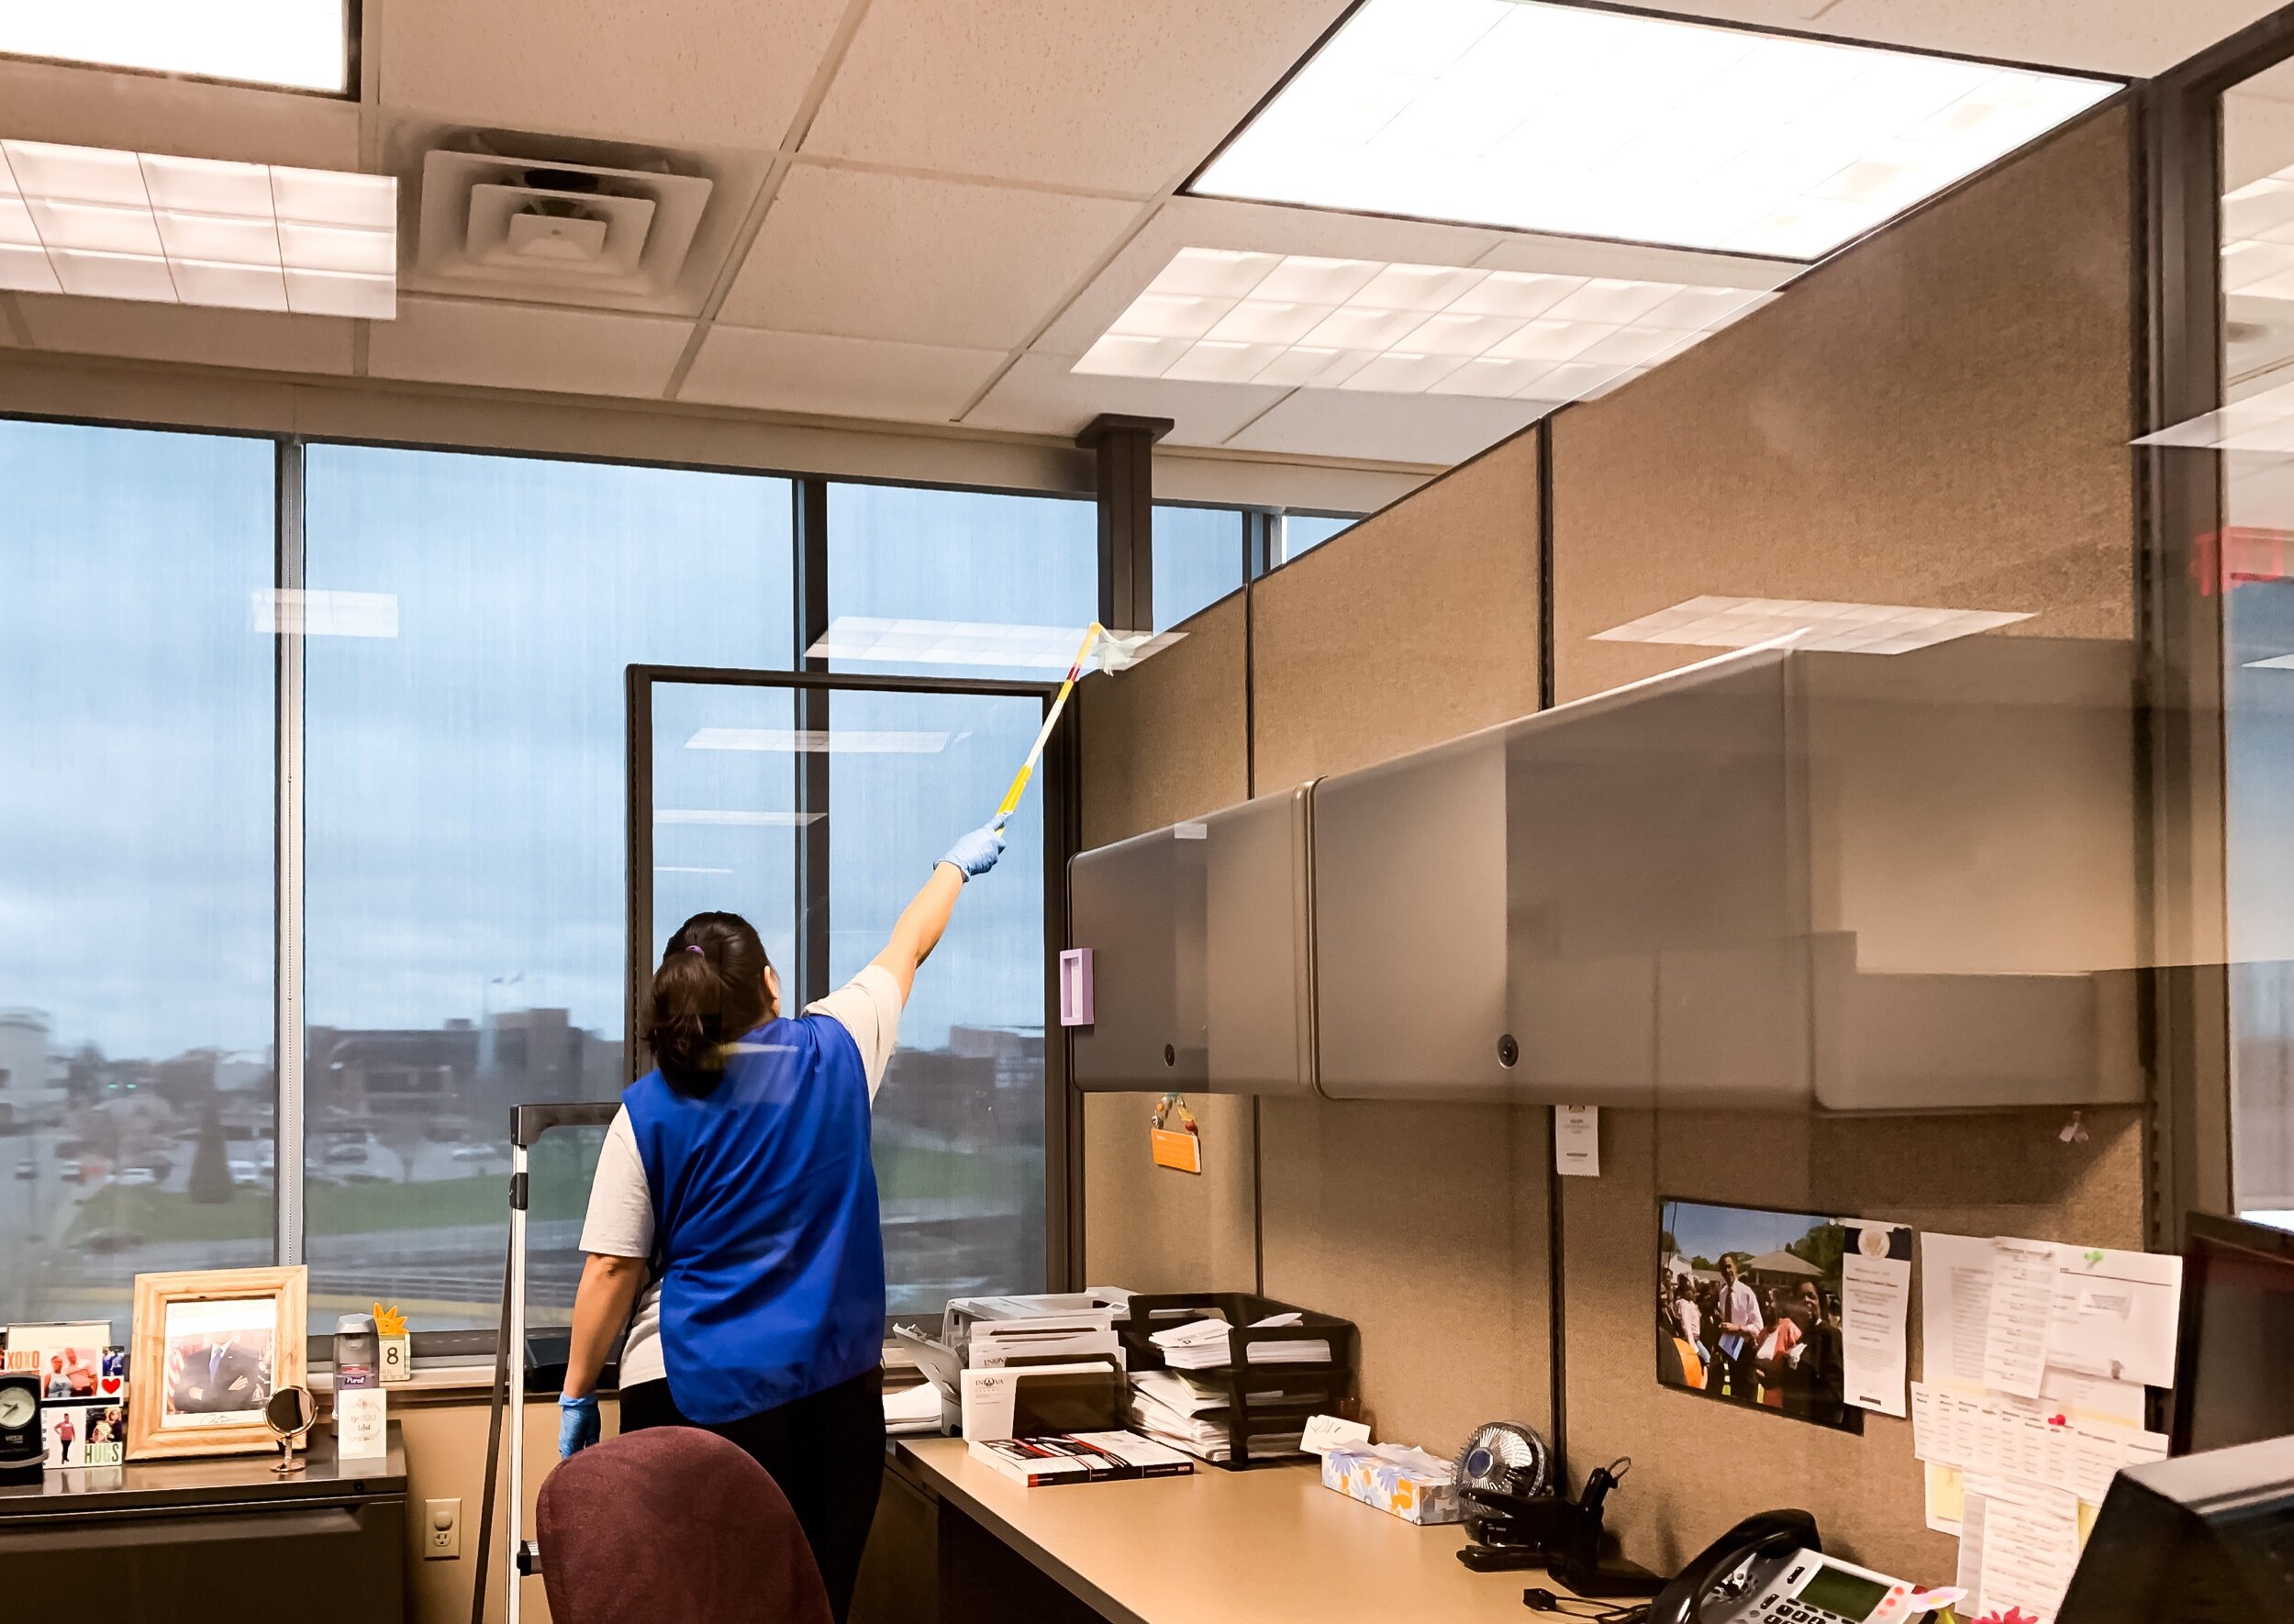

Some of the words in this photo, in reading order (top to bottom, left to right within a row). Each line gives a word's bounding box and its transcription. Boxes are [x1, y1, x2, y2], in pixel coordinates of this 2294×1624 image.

[6, 1351, 39, 1369] XOXO
[387, 1347, 398, 1364] 8
[975, 1377, 1004, 1386] INOVA
[84, 1443, 119, 1463] HUGS
